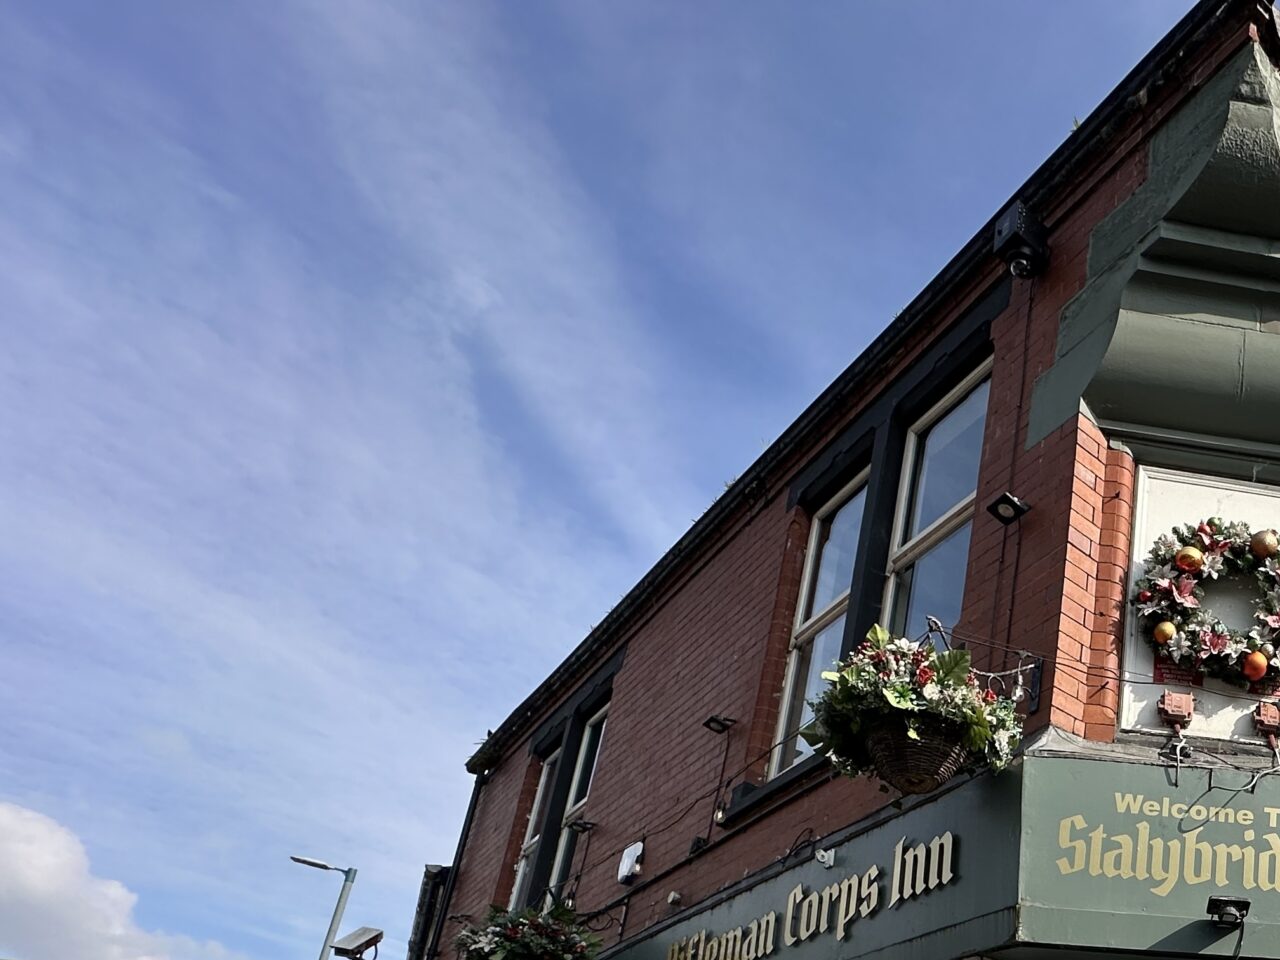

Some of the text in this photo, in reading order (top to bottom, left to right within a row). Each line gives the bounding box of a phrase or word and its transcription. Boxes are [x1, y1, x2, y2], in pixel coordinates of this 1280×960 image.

[1114, 792, 1254, 825] Welcome
[783, 863, 880, 947] Corps
[887, 830, 954, 909] Inn
